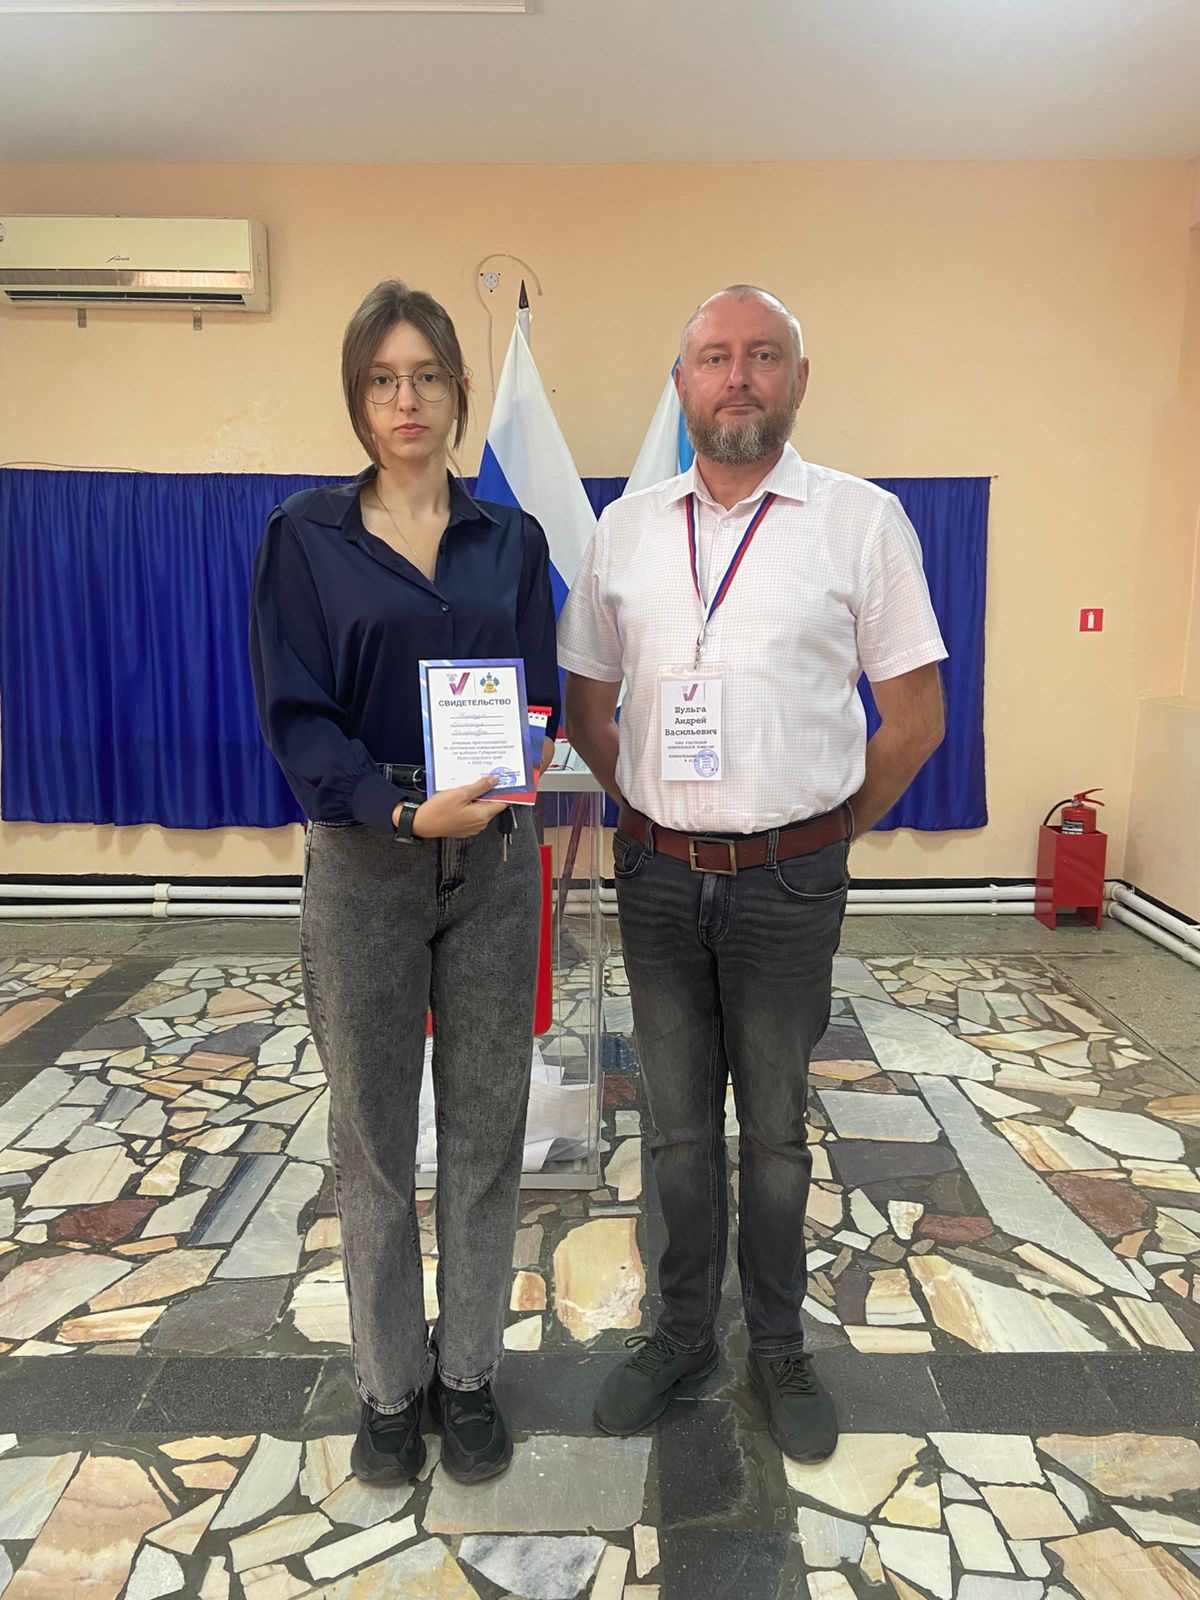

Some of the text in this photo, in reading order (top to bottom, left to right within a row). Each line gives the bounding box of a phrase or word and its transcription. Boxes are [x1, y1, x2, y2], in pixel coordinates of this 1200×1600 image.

[438, 698, 511, 707] СВИДЕТЕЛЬСТВО
[674, 706, 706, 714] Шульга
[675, 717, 706, 726] Андрей
